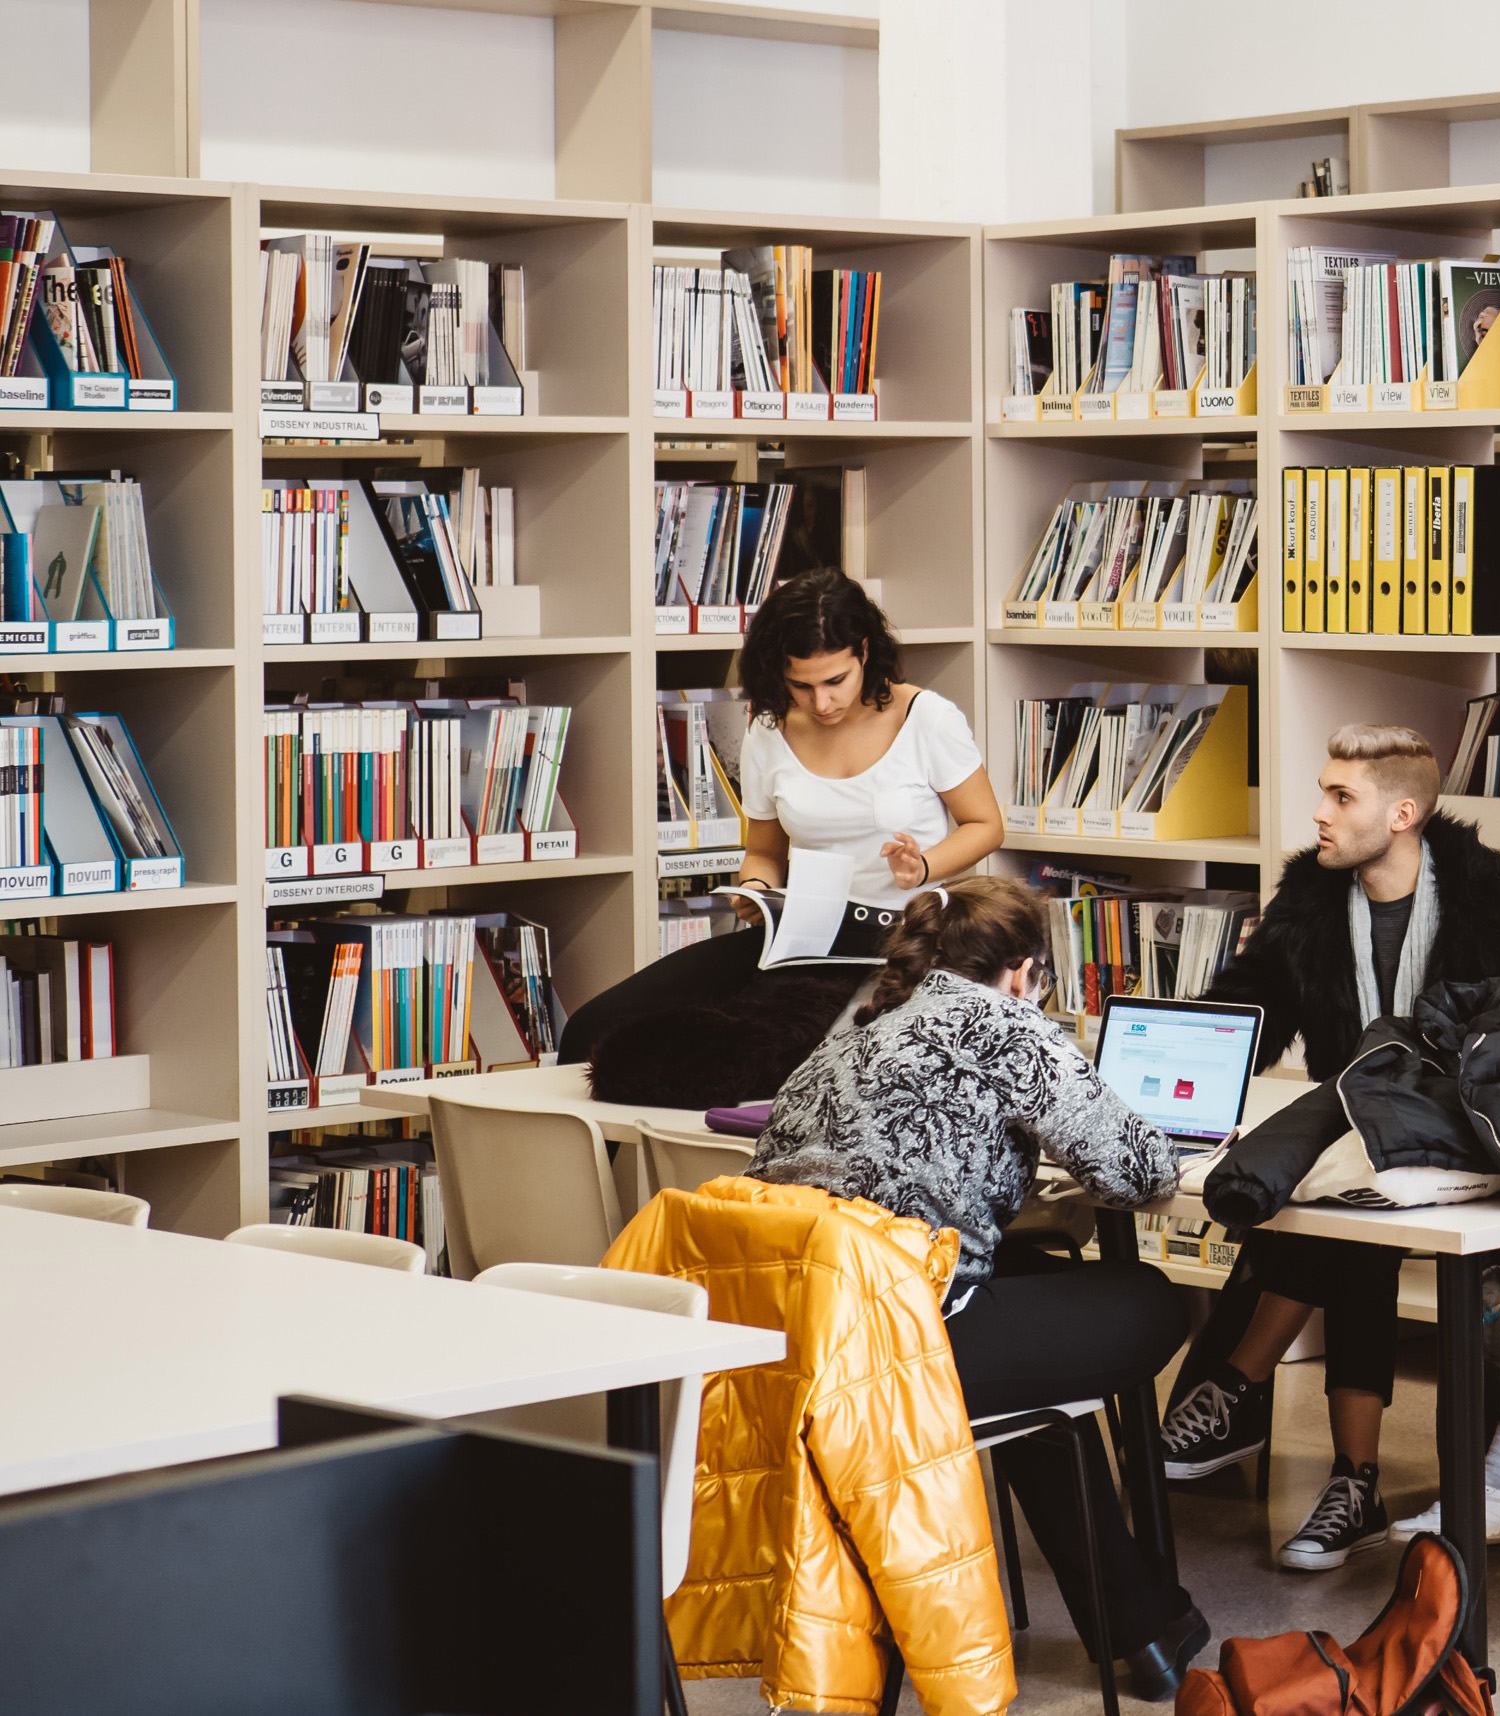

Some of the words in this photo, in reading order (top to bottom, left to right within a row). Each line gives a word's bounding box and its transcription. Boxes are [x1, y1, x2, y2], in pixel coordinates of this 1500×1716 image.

[1324, 256, 1359, 268] TEXTILES
[0, 388, 45, 401] baseline
[84, 391, 106, 399] Studio
[1289, 390, 1320, 401] TEXTILES
[1336, 391, 1357, 404] view
[1381, 389, 1402, 402] view
[1429, 384, 1450, 399] view
[696, 399, 728, 409] Ottagono
[743, 399, 782, 413] Ottagono
[795, 401, 826, 411] PASAJES
[834, 400, 874, 410] Quaderns
[1042, 400, 1072, 411] Intima
[1200, 396, 1234, 408] L'UOMO
[270, 420, 310, 430] DISSENY
[313, 421, 368, 432] INDUSTRIAL
[1432, 496, 1441, 530] Iberia
[1309, 500, 1317, 541] RADIUM
[656, 614, 686, 623] CTONICA
[1006, 609, 1037, 620] bambini
[1081, 611, 1112, 623] VOGUE
[1163, 611, 1195, 623] VOGUE
[263, 623, 302, 635] NTERNI
[313, 622, 358, 633] INTERNI
[372, 621, 416, 633] INTERNI
[0, 633, 43, 643] EMIGRE
[665, 859, 701, 870] DISSENY
[703, 858, 714, 868] DE
[716, 857, 740, 867] MODA
[0, 874, 48, 889] novum
[68, 868, 112, 884] novum
[273, 886, 313, 898] DISSENY
[316, 883, 375, 896] D'INTERIORS
[1209, 1242, 1236, 1256] TEXTILE
[1209, 1254, 1236, 1267] LEADER
